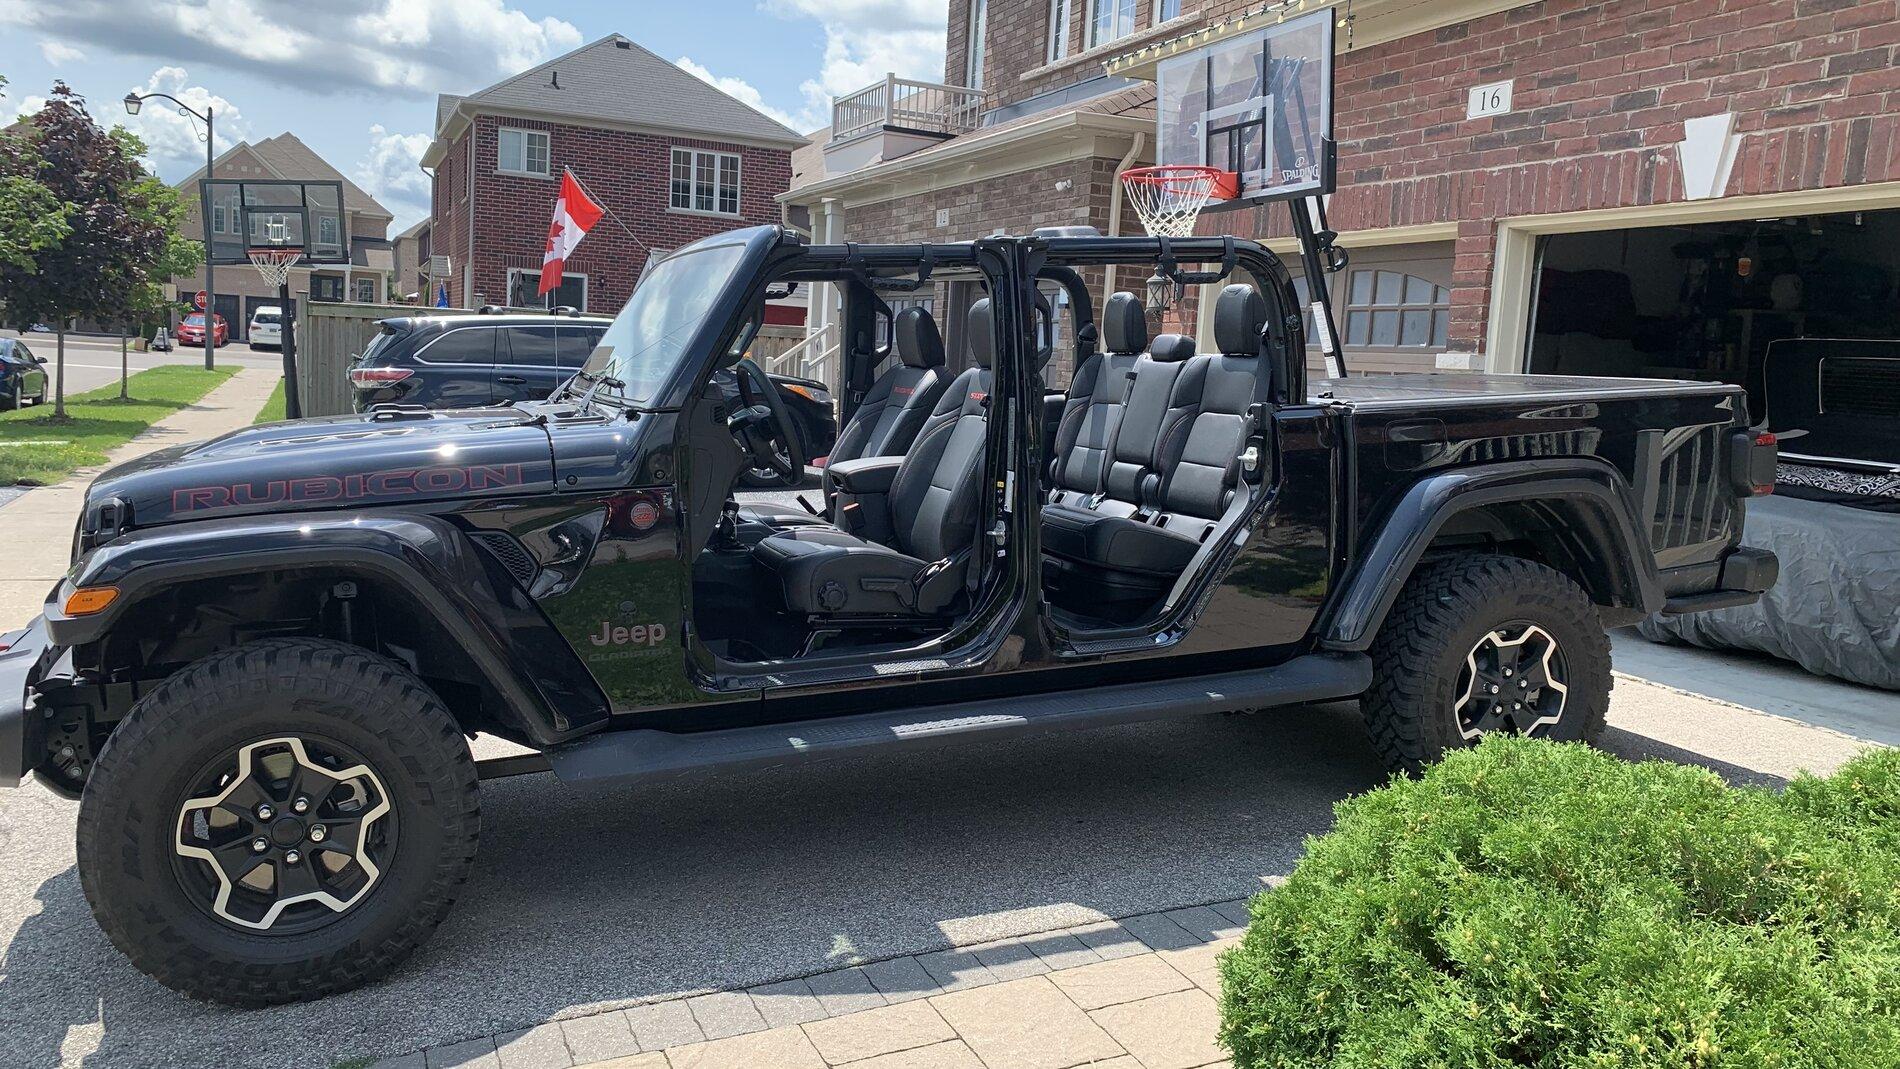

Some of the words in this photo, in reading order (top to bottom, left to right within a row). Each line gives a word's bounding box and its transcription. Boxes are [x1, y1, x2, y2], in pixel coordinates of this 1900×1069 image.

[1480, 87, 1501, 112] 16
[1281, 163, 1319, 184] SPALDING
[173, 462, 522, 513] RUBICON
[590, 621, 666, 647] Jeep
